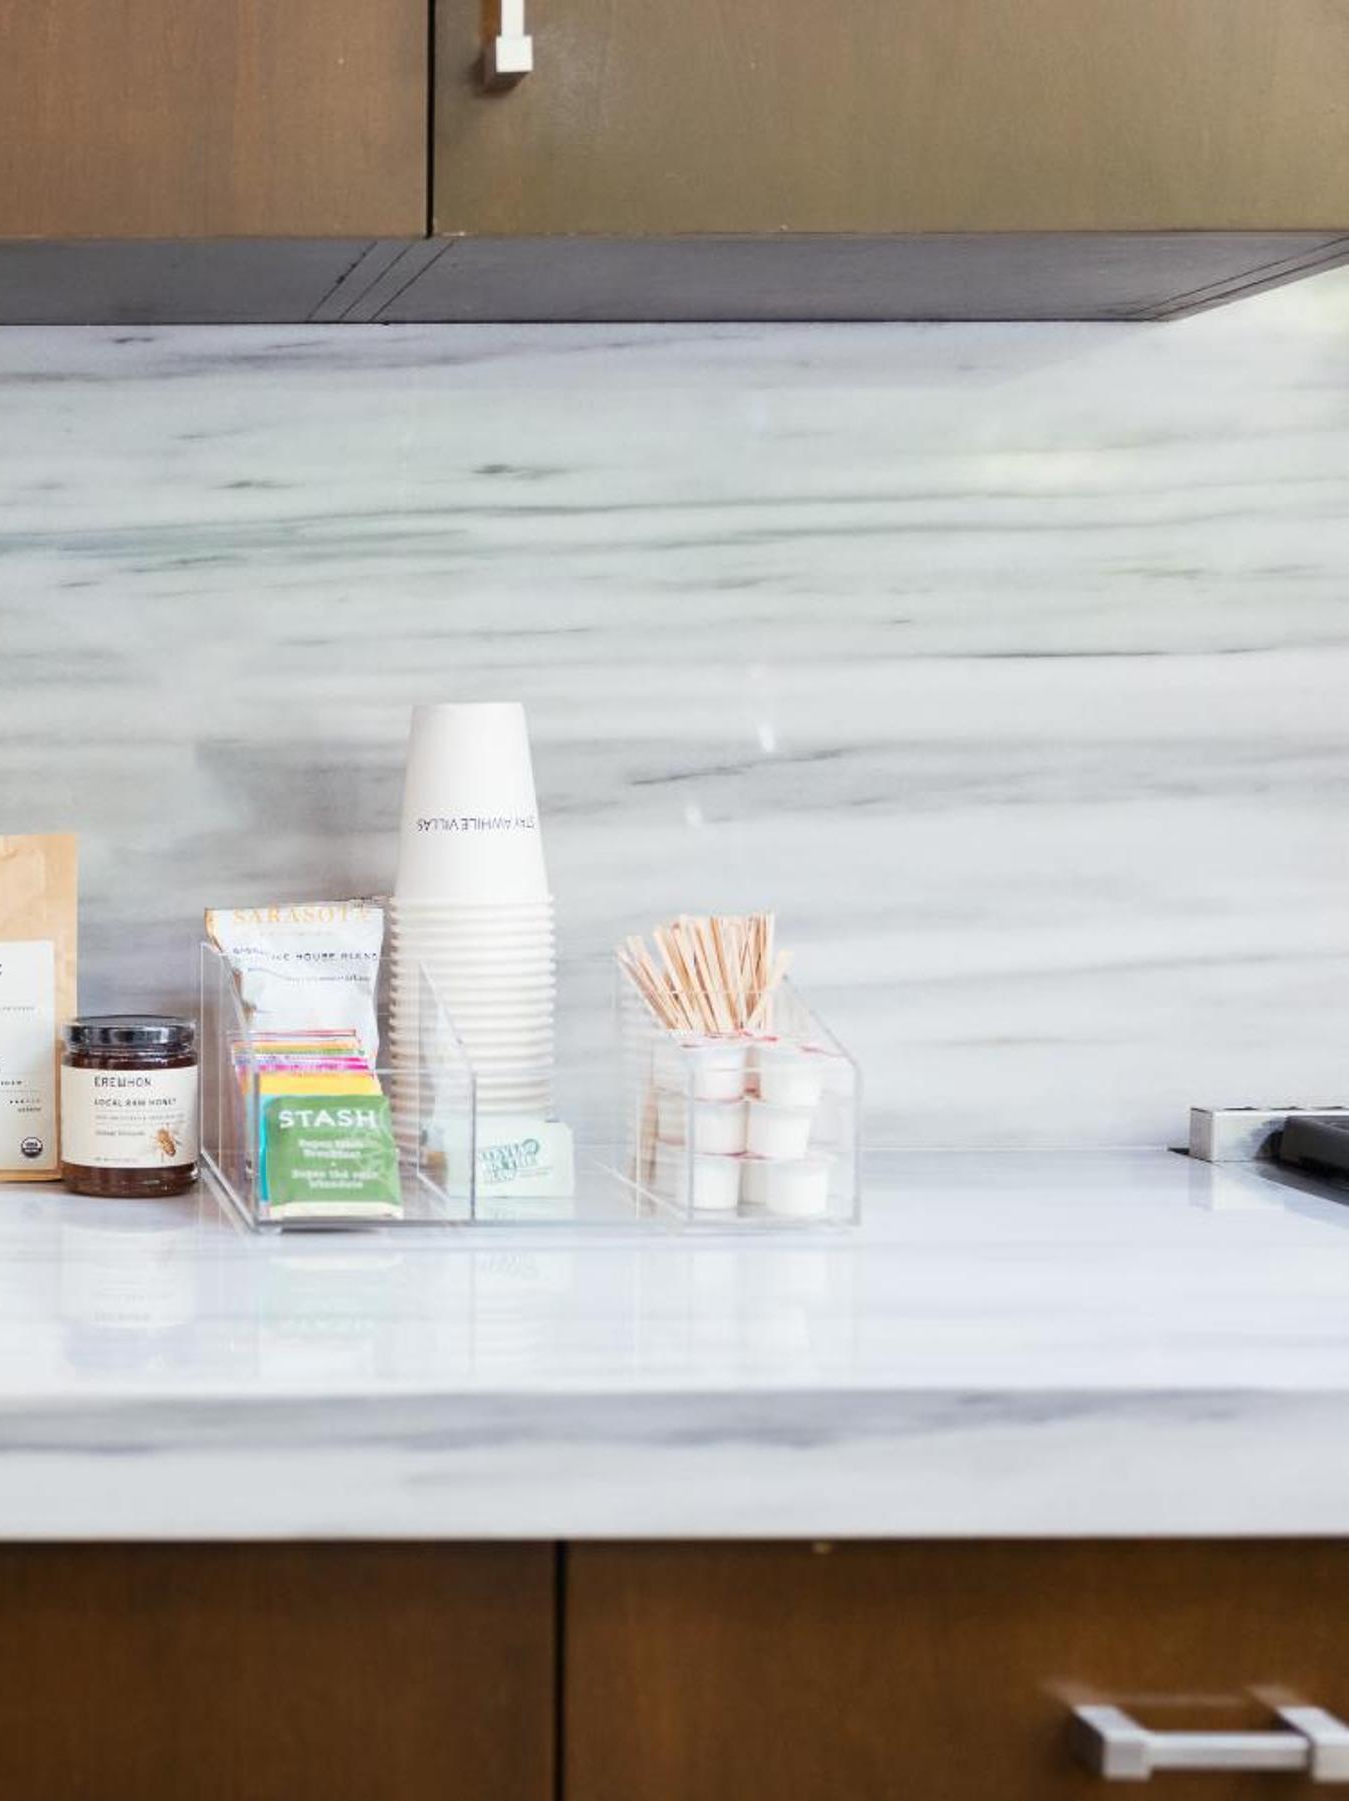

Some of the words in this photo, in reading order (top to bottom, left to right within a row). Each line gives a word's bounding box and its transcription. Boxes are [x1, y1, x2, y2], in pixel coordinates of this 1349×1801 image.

[416, 818, 459, 832] VILLAS
[93, 1076, 153, 1087] EREWHON
[93, 1097, 123, 1107] LOCAL
[278, 1109, 377, 1129] STASH
